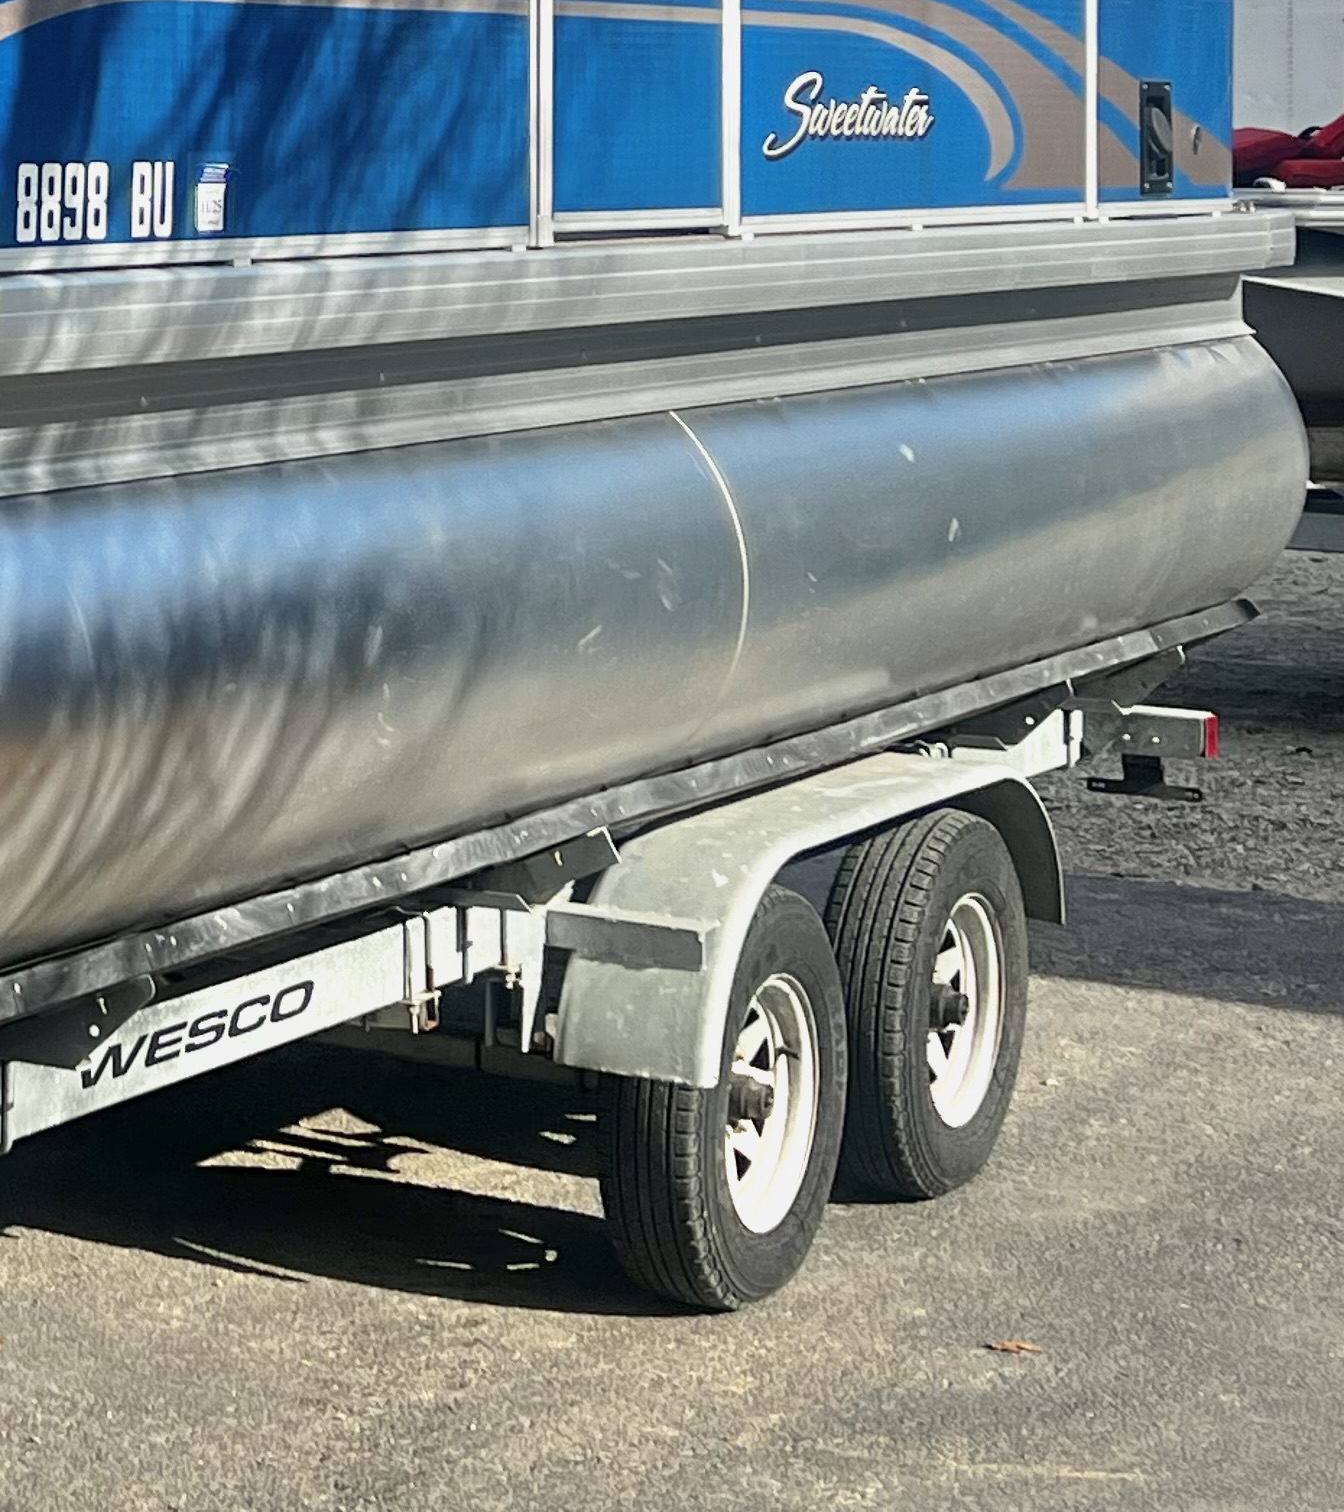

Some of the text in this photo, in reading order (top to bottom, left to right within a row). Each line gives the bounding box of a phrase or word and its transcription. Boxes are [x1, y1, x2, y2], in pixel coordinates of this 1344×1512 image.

[762, 70, 935, 160] Sweetwater
[15, 160, 110, 243] 8898
[130, 160, 175, 238] BU
[79, 980, 315, 1090] WESCO
